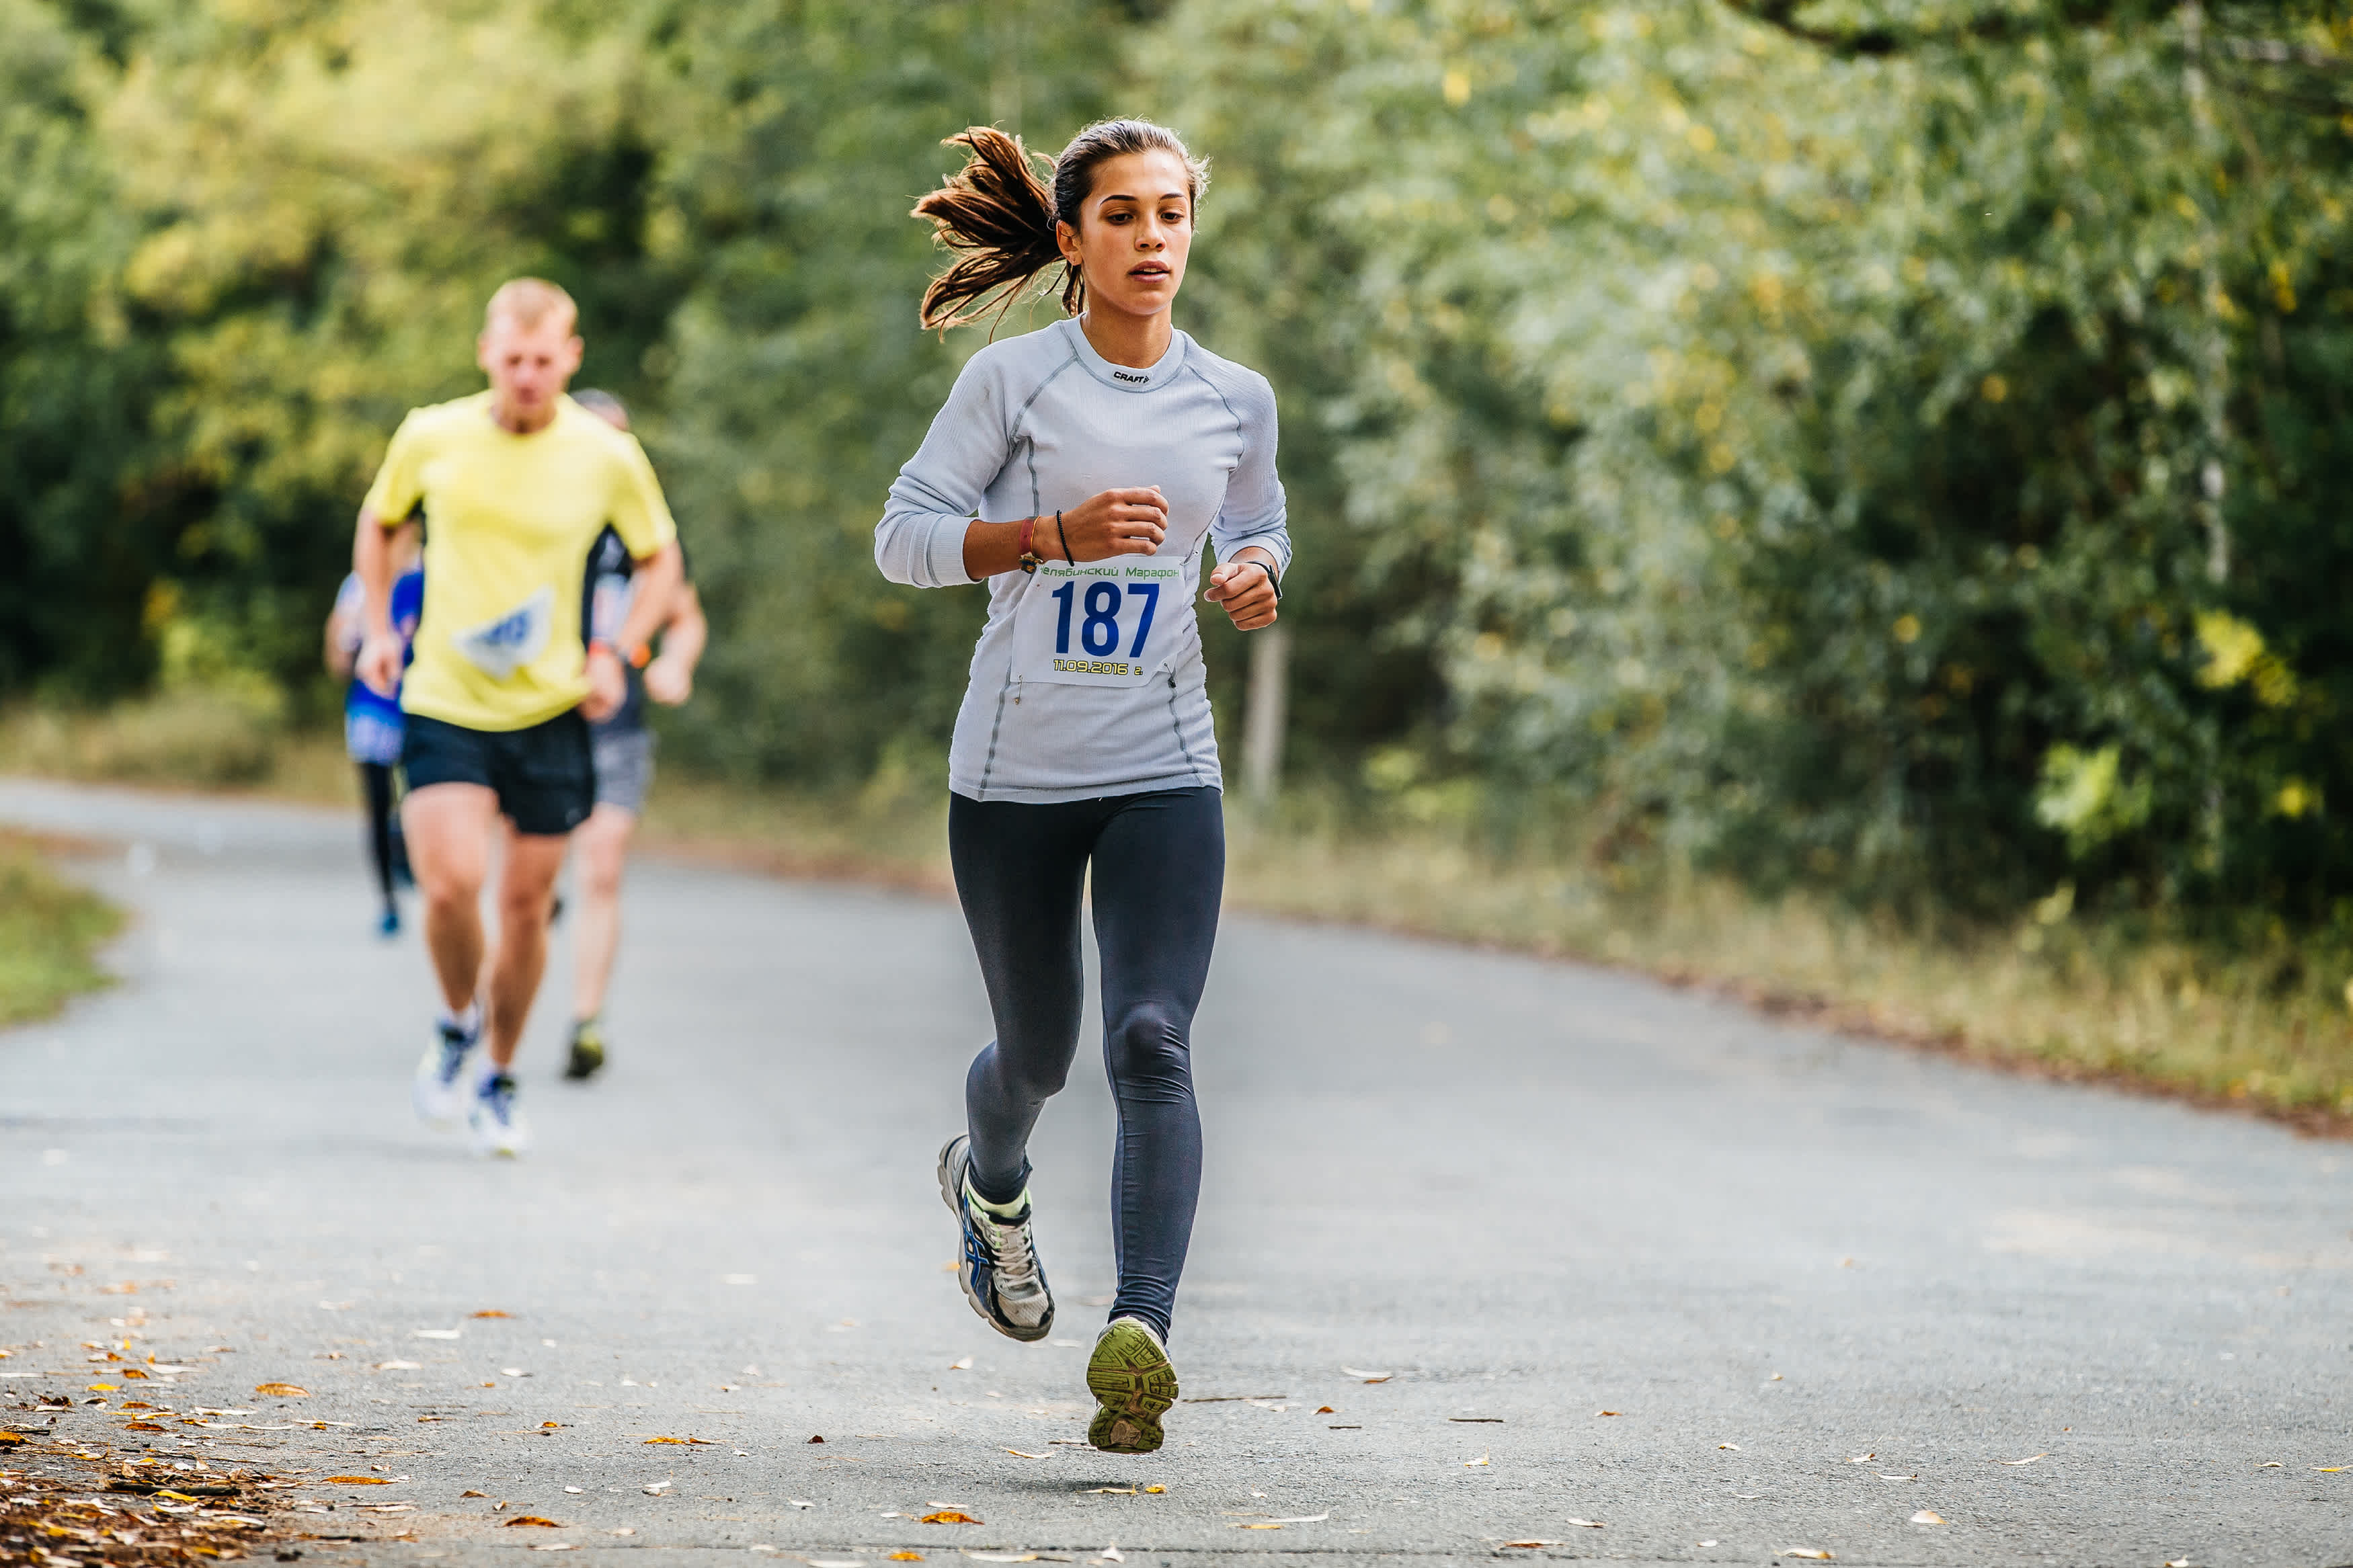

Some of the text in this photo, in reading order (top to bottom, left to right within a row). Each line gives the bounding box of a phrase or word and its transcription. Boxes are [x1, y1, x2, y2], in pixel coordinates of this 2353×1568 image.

[1113, 372, 1144, 383] CRAFT
[1125, 567, 1179, 580] Марафон
[1051, 581, 1160, 658] 187
[1053, 659, 1129, 675] 11.09.2016
